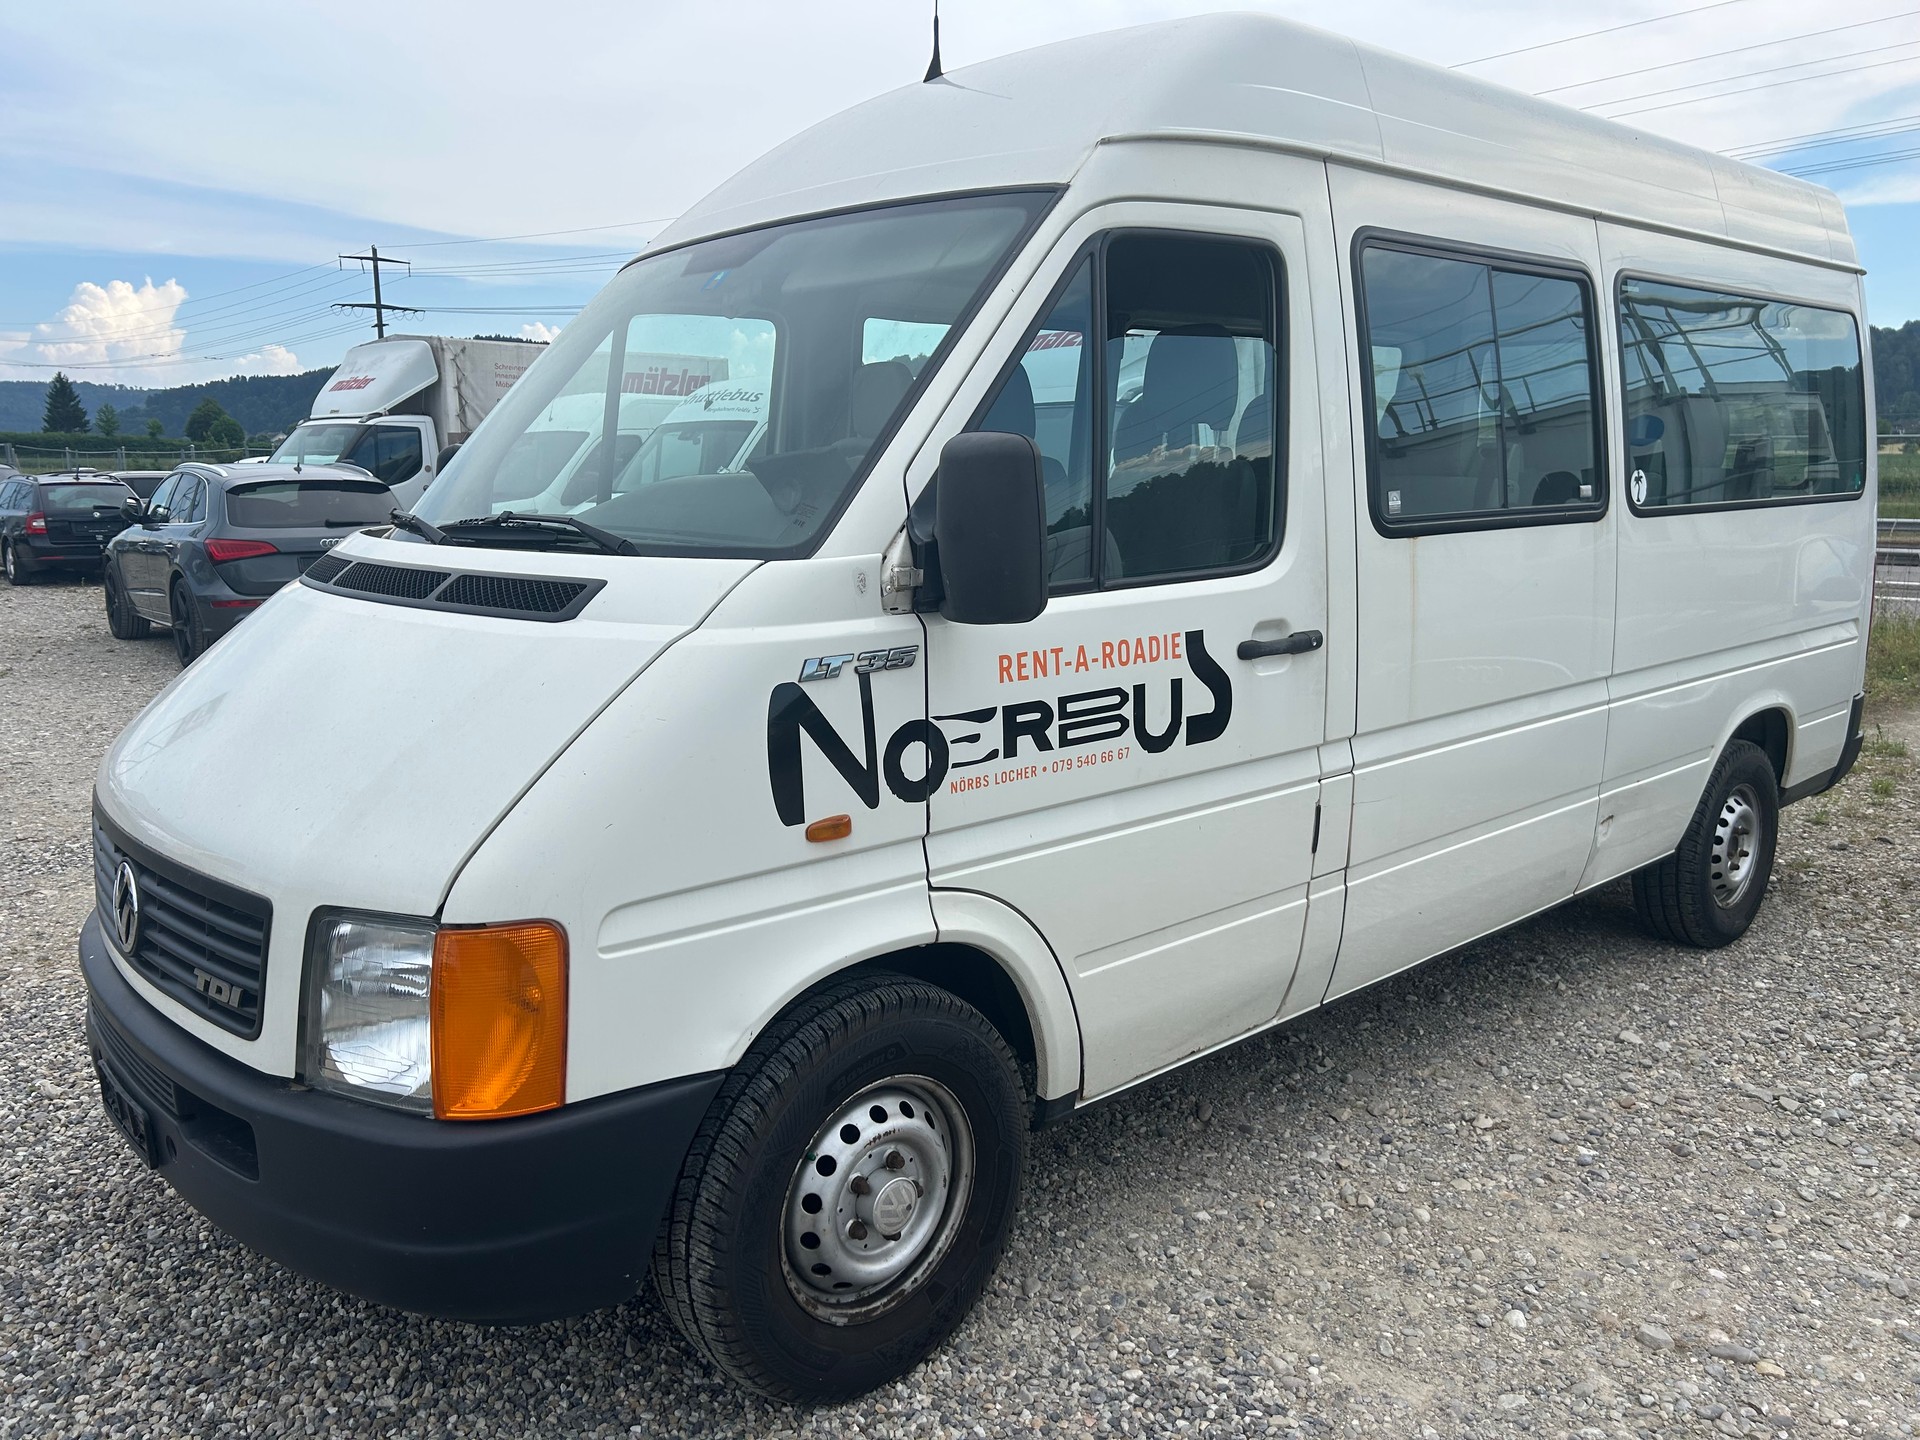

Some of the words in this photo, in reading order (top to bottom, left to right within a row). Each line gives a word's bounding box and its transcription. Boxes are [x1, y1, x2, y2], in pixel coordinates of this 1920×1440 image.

[798, 653, 854, 682] LT
[854, 645, 919, 674] 35
[999, 632, 1181, 684] RENT-A-ROADIE
[950, 774, 989, 794] NÖRBS
[994, 765, 1037, 785] LOCHER
[1052, 758, 1073, 773] 079
[1076, 753, 1097, 768] 540
[1100, 750, 1114, 763] 66
[1117, 746, 1130, 760] 67
[194, 967, 243, 1008] TDI
